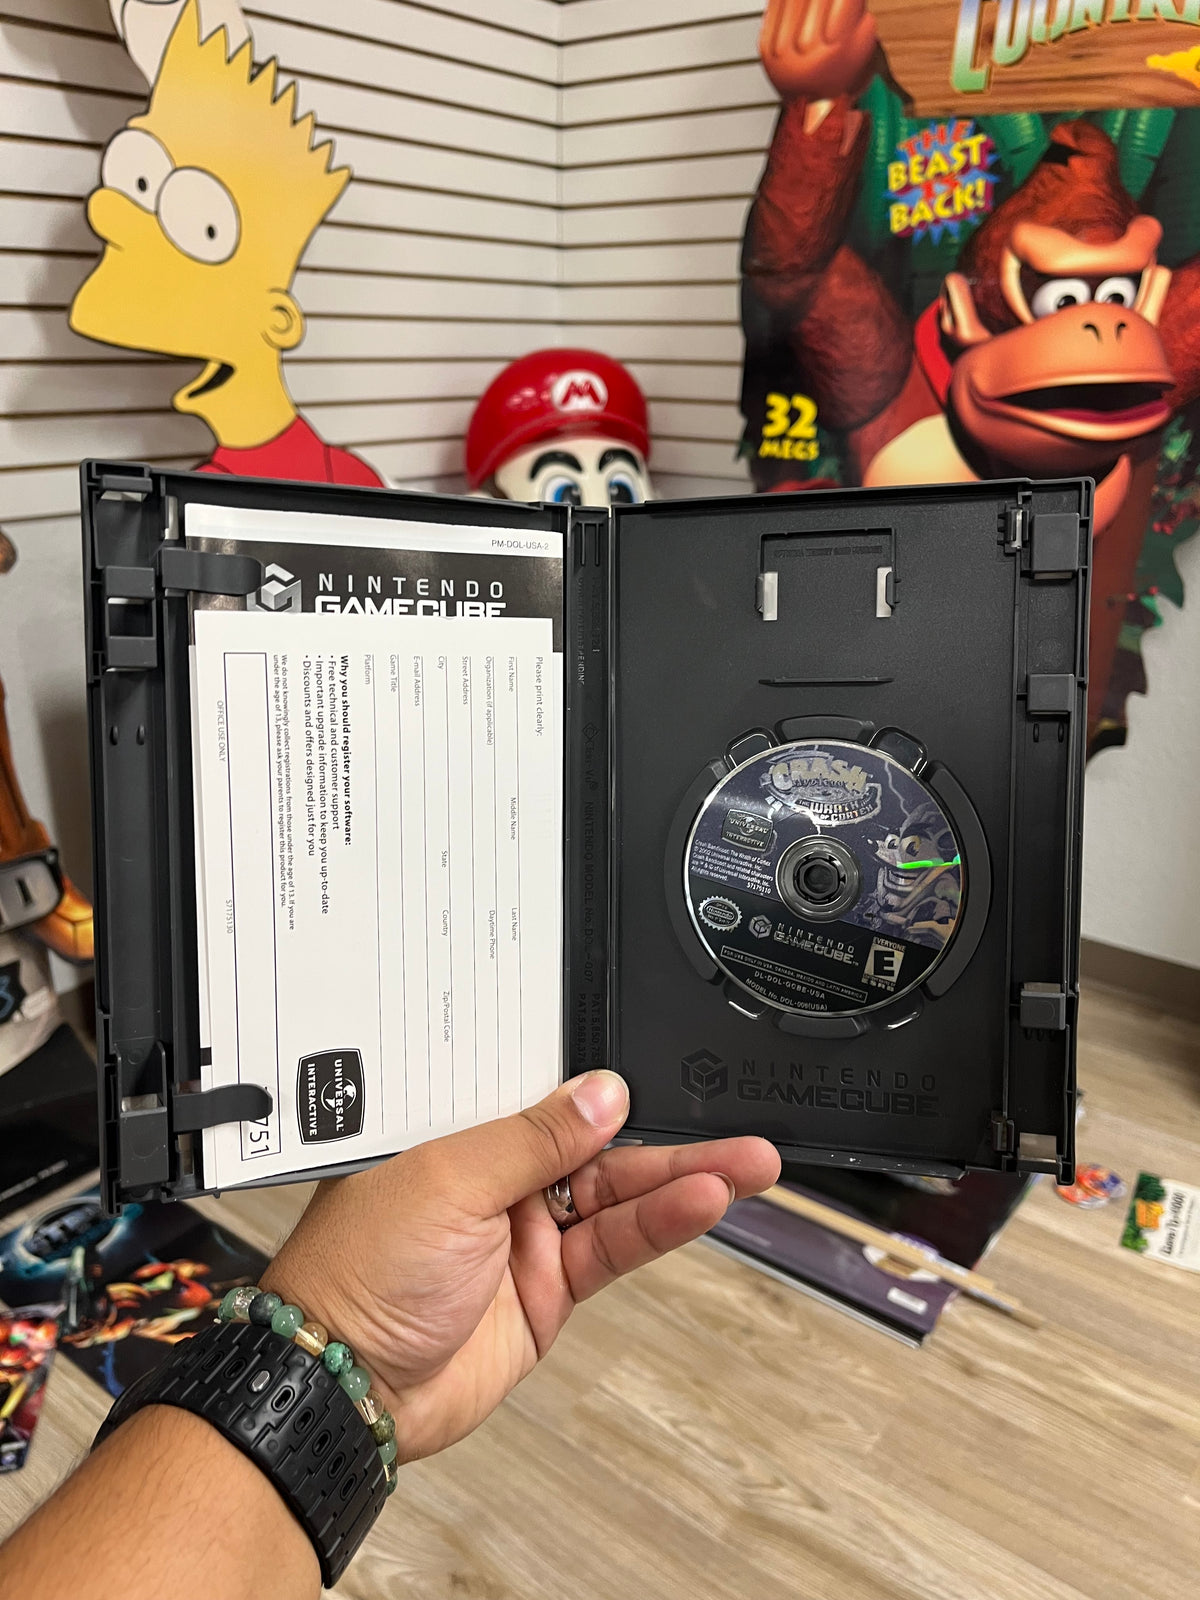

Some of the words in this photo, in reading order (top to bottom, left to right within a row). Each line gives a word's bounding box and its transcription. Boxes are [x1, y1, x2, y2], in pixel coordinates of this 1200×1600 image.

[887, 133, 988, 192] BEAST
[888, 179, 987, 234] BACK!
[562, 382, 601, 405] M
[762, 392, 819, 439] 32
[491, 538, 550, 551] PM-DOL-USA-2
[318, 572, 505, 598] NINTENDO
[281, 654, 287, 665] We
[281, 667, 288, 676] do
[328, 661, 336, 680] Free
[338, 655, 348, 676] Why
[389, 654, 397, 675] Game
[437, 655, 445, 669] City
[535, 656, 543, 683] Please
[302, 661, 312, 707] Discounts
[313, 660, 324, 708] Important
[339, 679, 347, 697] you
[390, 676, 398, 692] Title
[484, 656, 492, 699] Organization
[328, 683, 338, 725] technical
[534, 685, 543, 704] print
[216, 700, 224, 726] OFFICE
[280, 691, 289, 726] knowingly
[304, 709, 313, 727] and
[342, 700, 350, 732] should
[535, 707, 544, 736] clearly:
[217, 727, 225, 740] USE
[274, 724, 282, 746] please
[282, 728, 290, 750] collect
[315, 711, 326, 750] upgrade
[330, 728, 338, 745] and
[485, 708, 493, 745] applicable)
[305, 730, 314, 756] offers
[340, 736, 351, 773] register
[283, 752, 292, 794] registrations
[304, 759, 315, 802] designed
[318, 753, 328, 807] information
[330, 748, 338, 790] customer
[772, 757, 868, 794] CRASH
[341, 775, 350, 797] your
[278, 804, 283, 812] to
[305, 804, 315, 821] just
[319, 810, 326, 819] to
[330, 793, 339, 829] support
[277, 813, 285, 838] register
[307, 823, 316, 836] for
[318, 822, 328, 844] keep
[344, 800, 353, 845] software:
[729, 818, 769, 834] UNIVERSAL
[306, 838, 314, 855] you
[725, 831, 765, 847] INTERACTIVE
[278, 854, 287, 881] product
[318, 846, 327, 863] you
[735, 865, 750, 873] related
[750, 869, 774, 880] characters
[279, 893, 288, 908] you.
[319, 866, 330, 913] up-to-date
[440, 909, 449, 936] Country
[487, 910, 496, 937] Daytime
[776, 922, 855, 953] NINTENDO
[873, 937, 907, 952] EVERYONE
[873, 950, 895, 977] E
[745, 977, 770, 997] MODEL
[826, 983, 839, 991] LATIN
[441, 991, 450, 1024] Zip/Postal
[741, 1058, 937, 1092] NINTENDO
[307, 1063, 317, 1136] INTERACTIVE
[334, 1059, 344, 1131] UNIVERSAL
[736, 1078, 942, 1119] GAMECUBE
